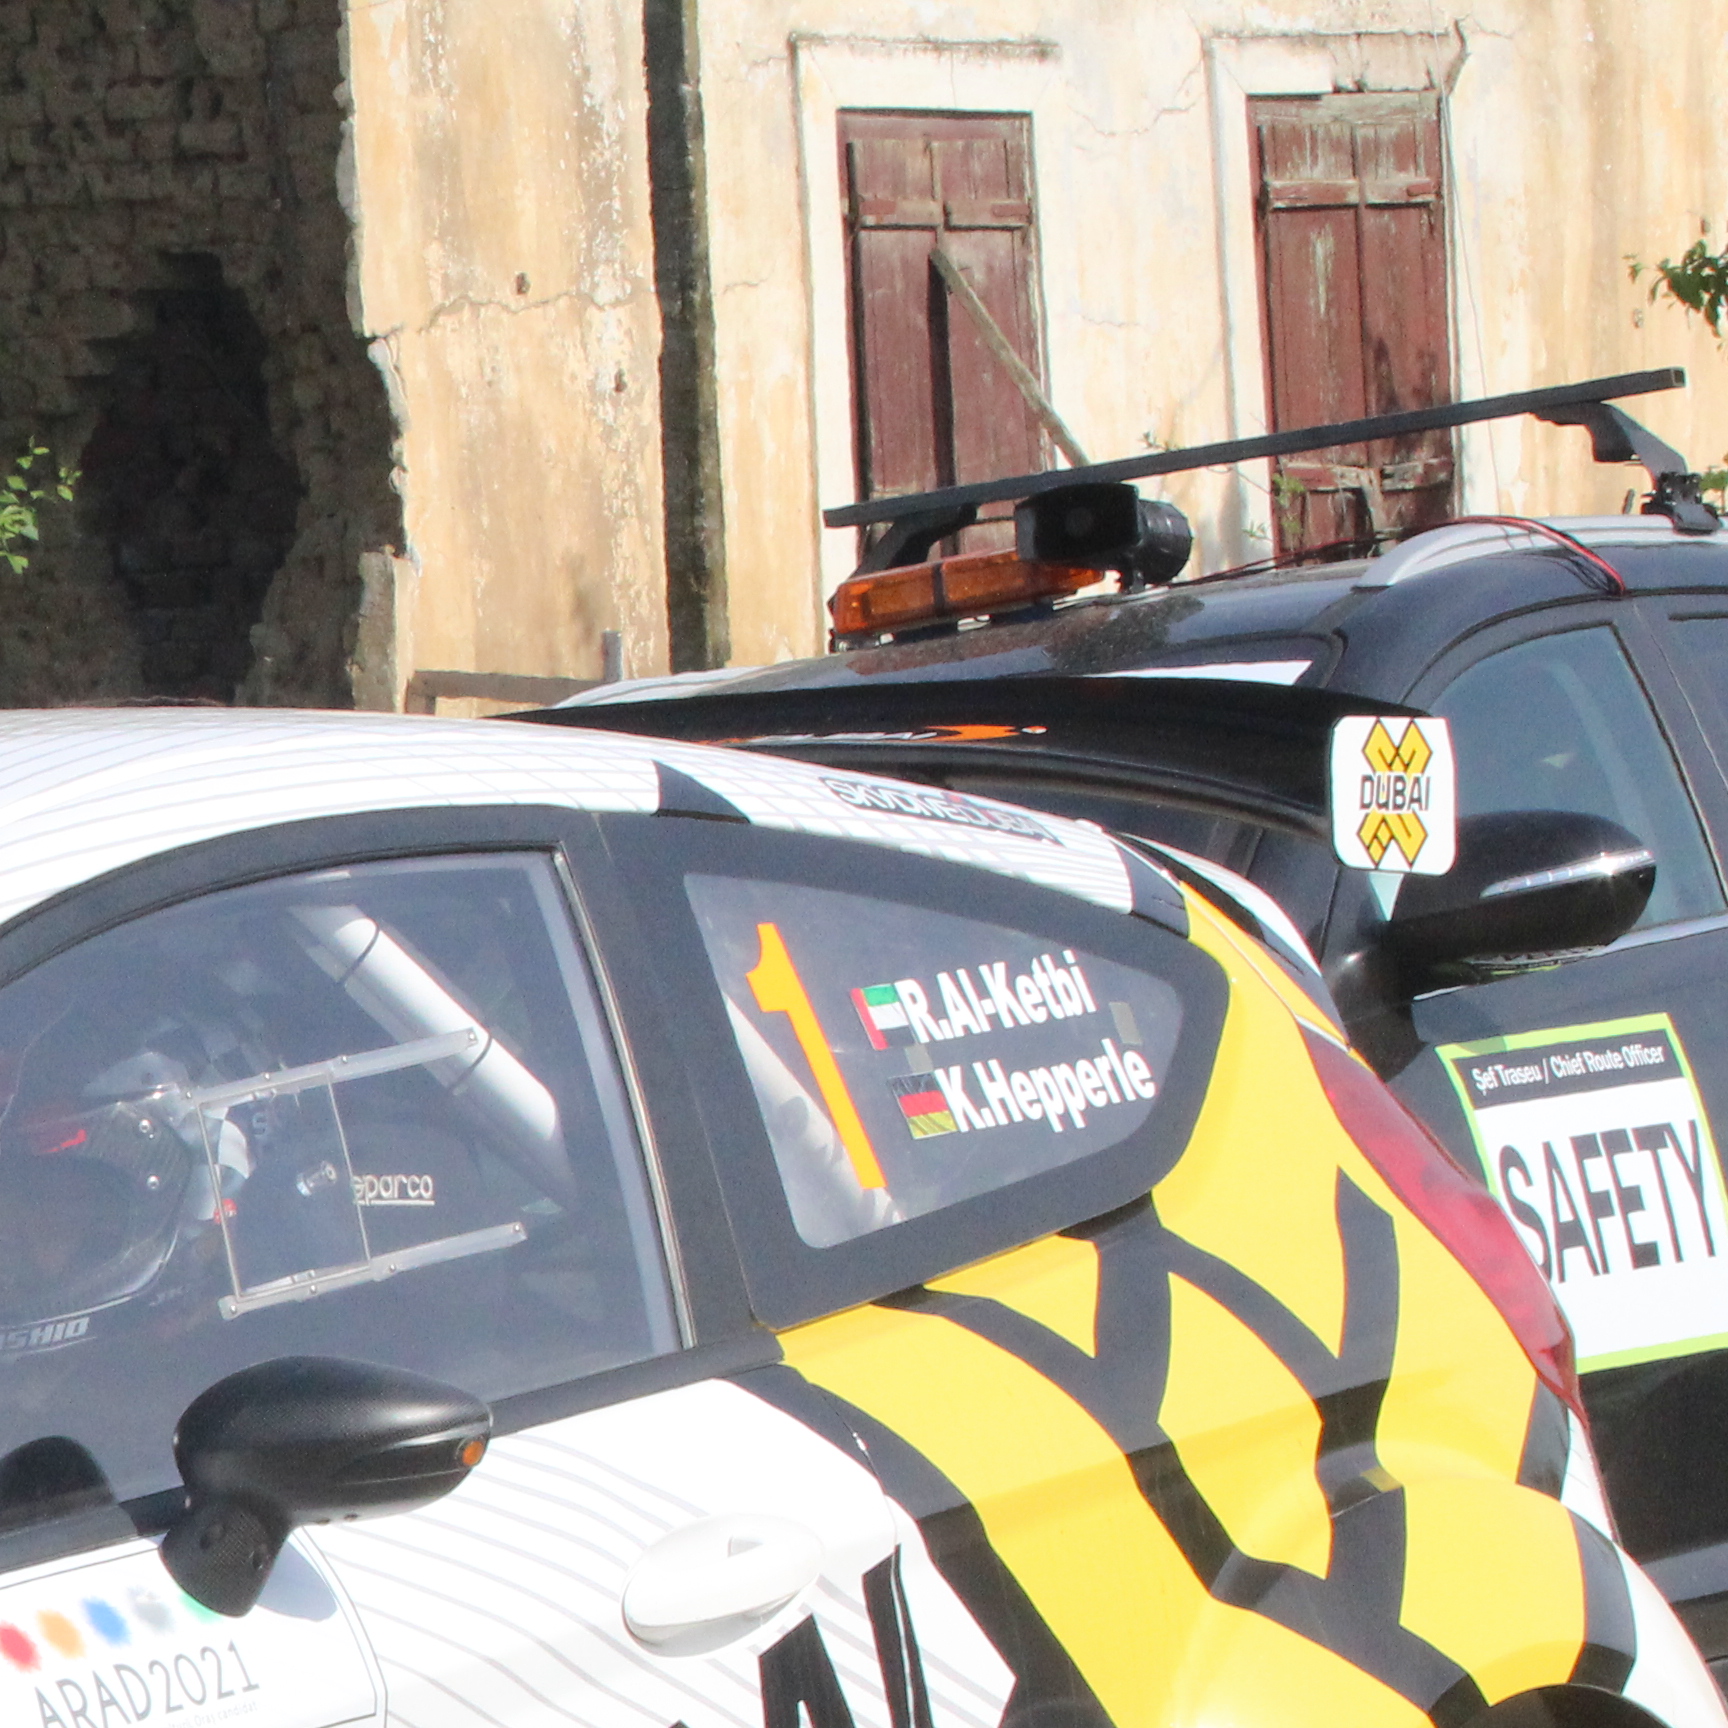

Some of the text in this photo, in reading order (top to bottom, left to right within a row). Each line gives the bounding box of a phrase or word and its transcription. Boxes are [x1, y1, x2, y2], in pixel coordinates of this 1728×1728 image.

[1359, 774, 1432, 812] DUBAI
[894, 949, 1099, 1044] R.Al-Ketbi
[745, 922, 888, 1190] 1
[932, 1037, 1156, 1134] K.Hepperle
[1496, 1062, 1543, 1088] Traseu
[1550, 1053, 1584, 1078] Chief
[1585, 1048, 1624, 1073] Route
[1623, 1043, 1665, 1068] Officer
[1499, 1119, 1717, 1285] SAFETY
